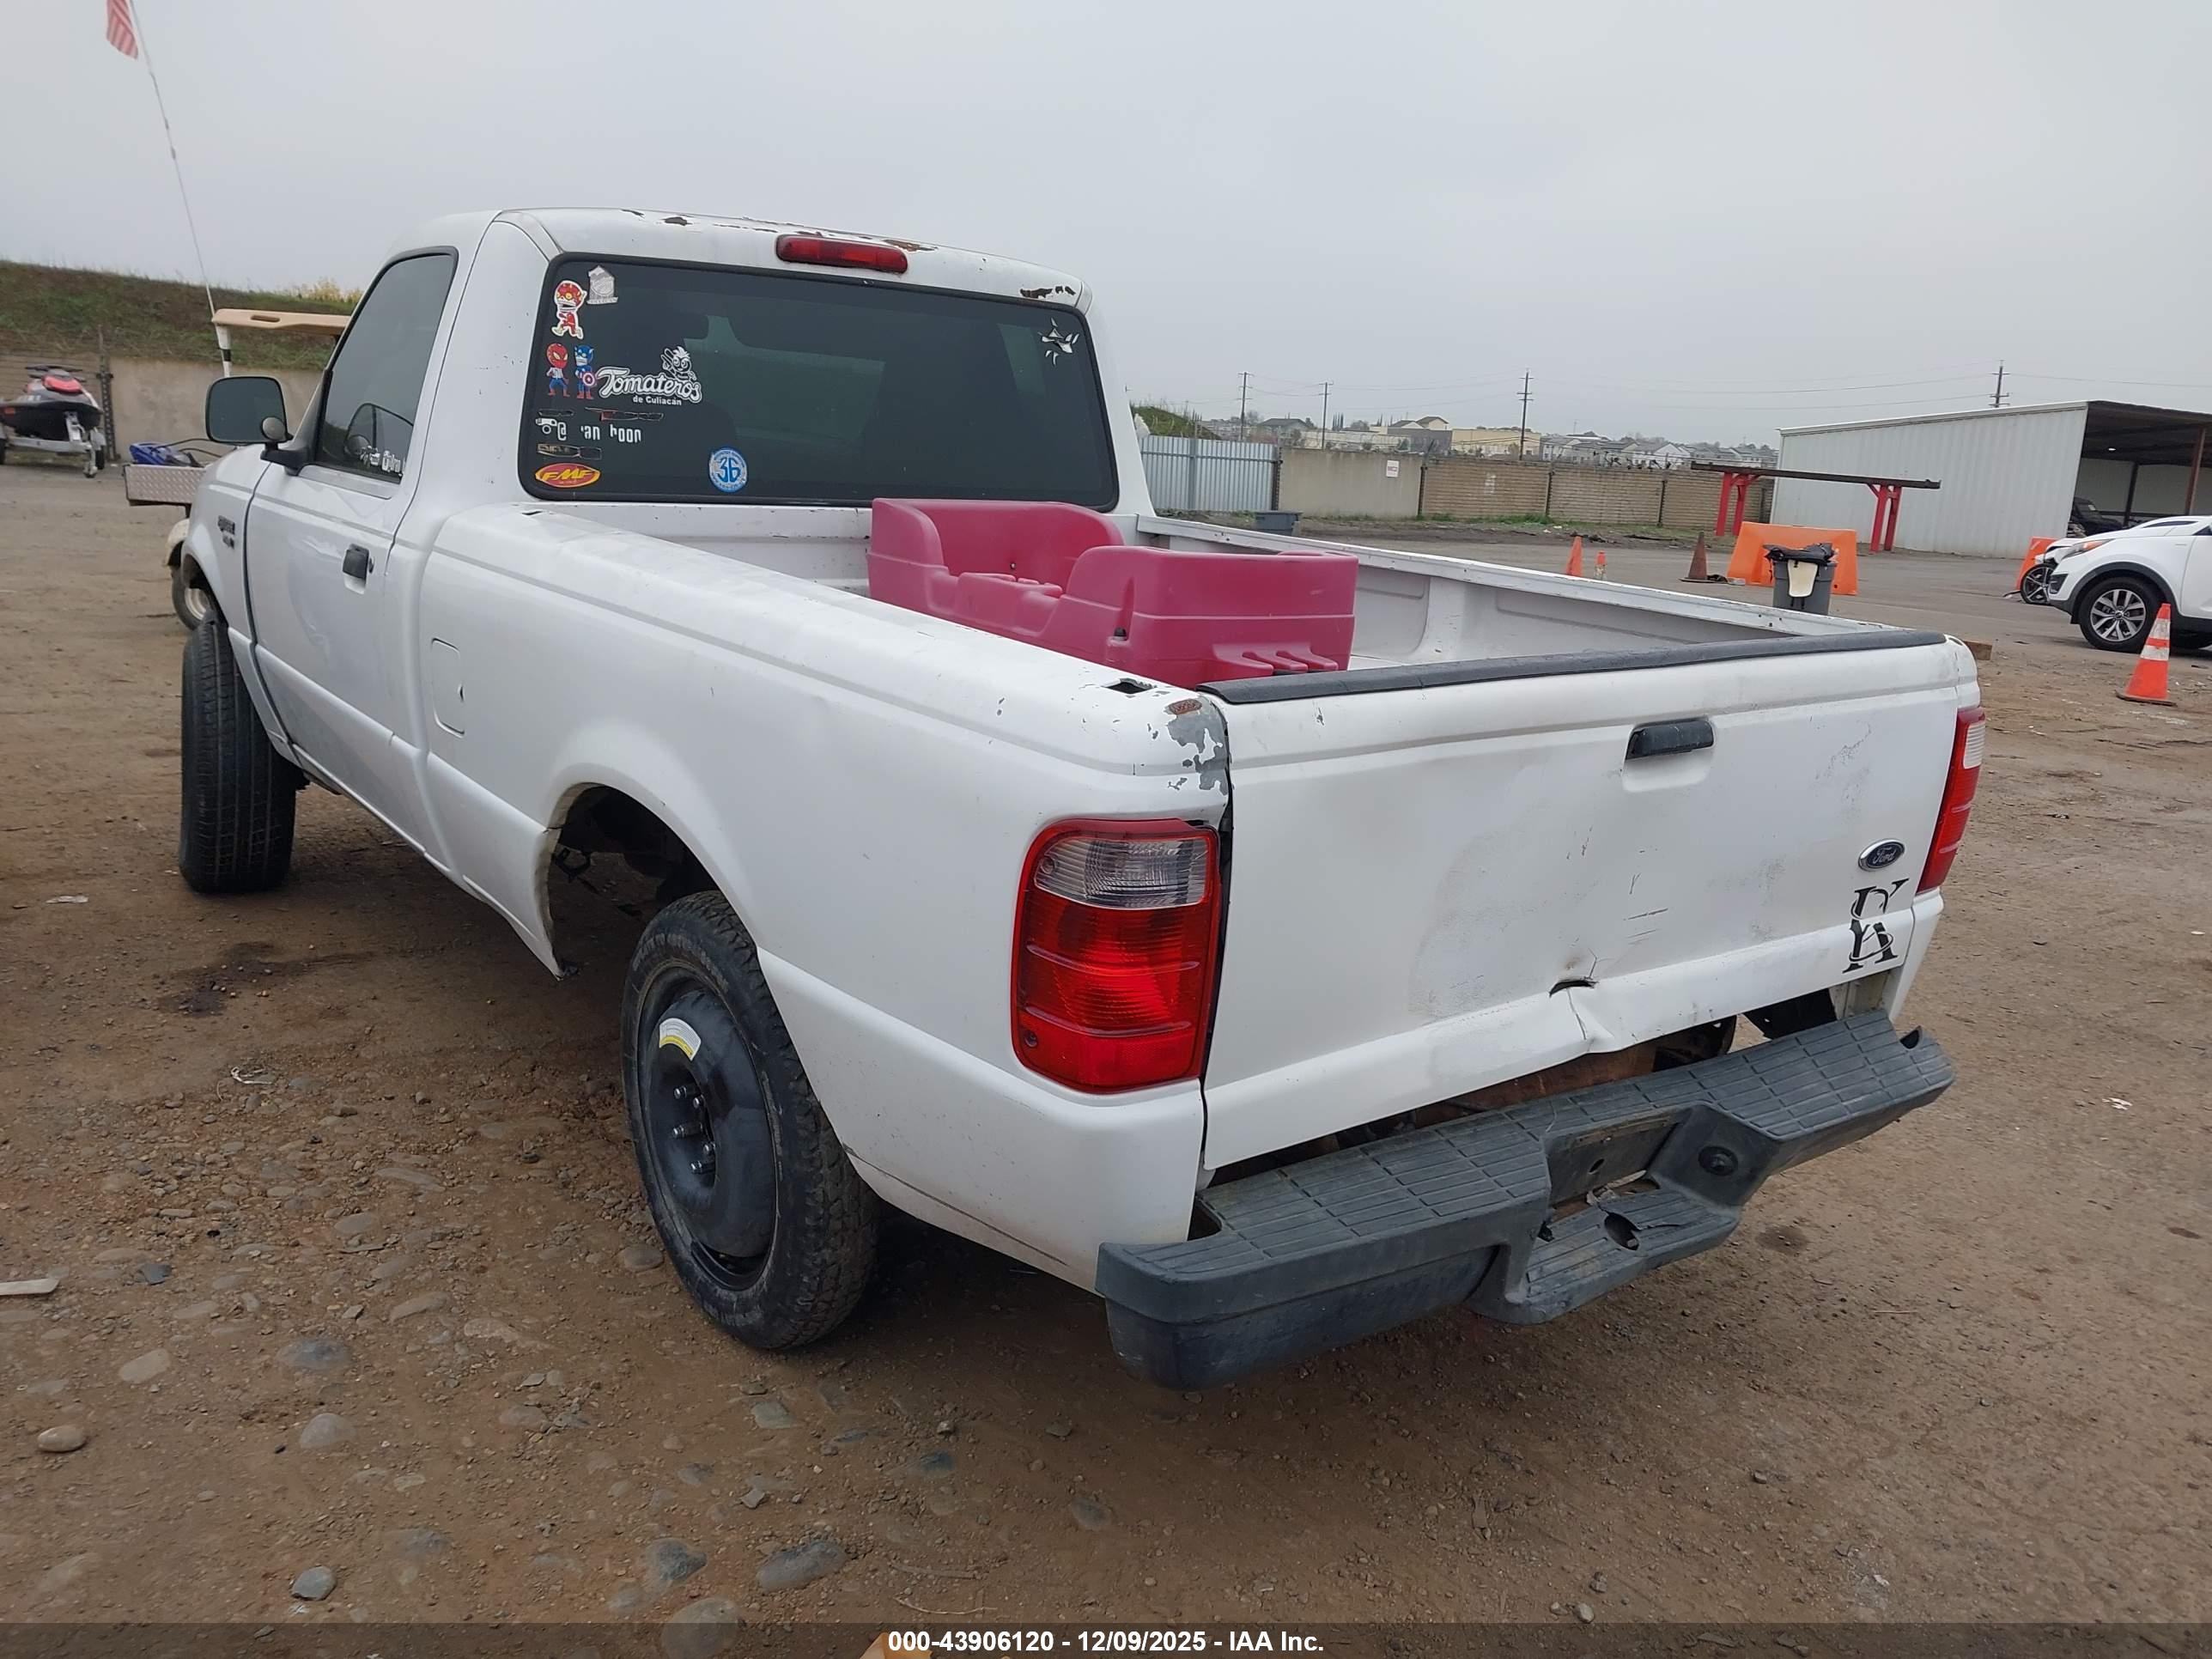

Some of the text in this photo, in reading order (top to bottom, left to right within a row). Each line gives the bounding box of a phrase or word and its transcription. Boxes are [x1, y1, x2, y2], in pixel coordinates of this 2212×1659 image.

[596, 367, 702, 403] Tomateros
[632, 395, 644, 404] de
[542, 468, 592, 482] FMF
[717, 456, 741, 483] 36
[1872, 846, 1897, 865] Ford
